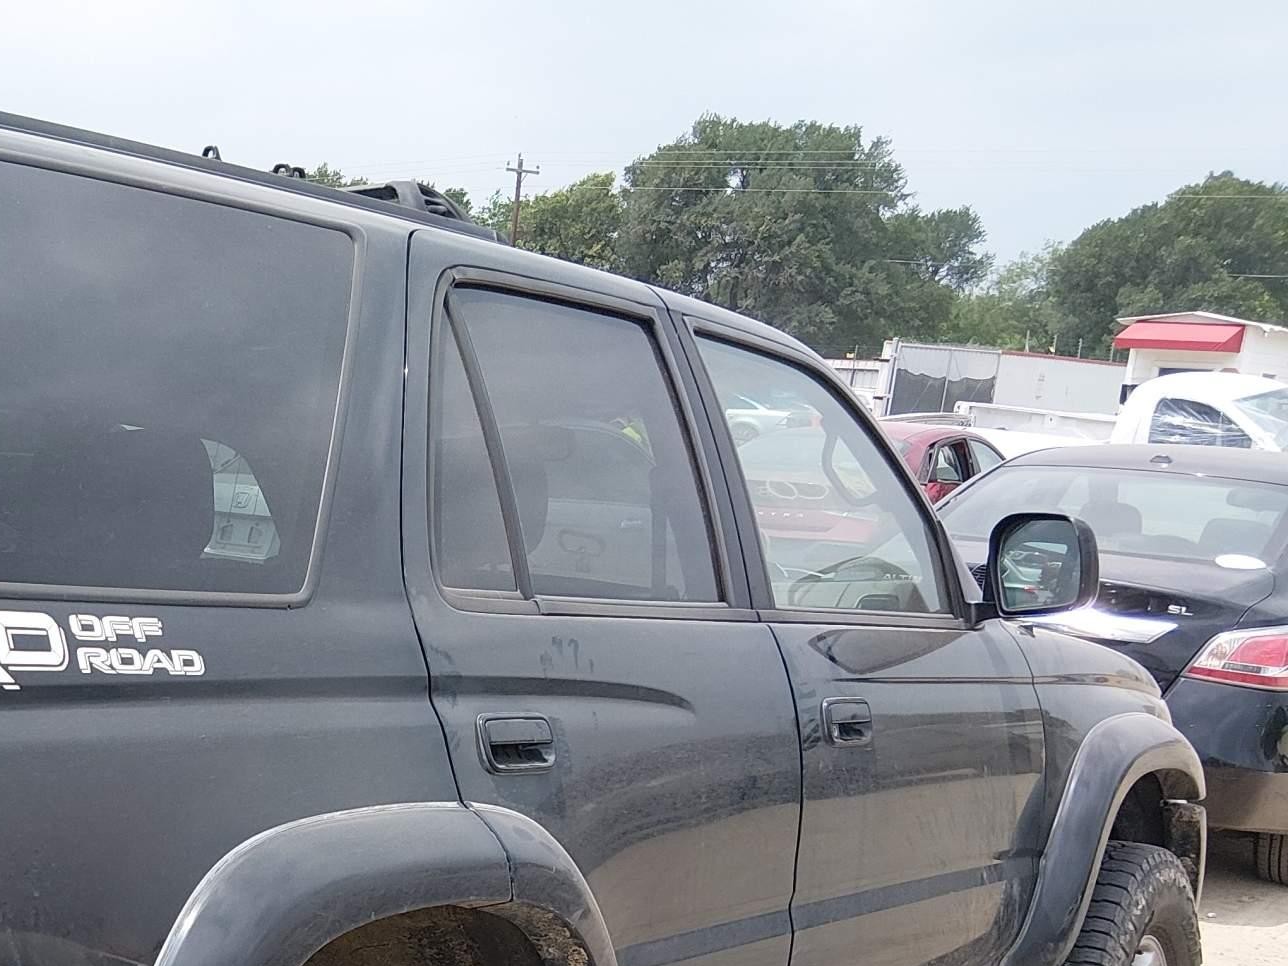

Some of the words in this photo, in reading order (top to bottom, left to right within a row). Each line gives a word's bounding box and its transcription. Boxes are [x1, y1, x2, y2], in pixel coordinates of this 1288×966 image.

[1167, 604, 1194, 617] SL
[69, 612, 164, 643] OFF
[75, 646, 207, 677] ROAD
